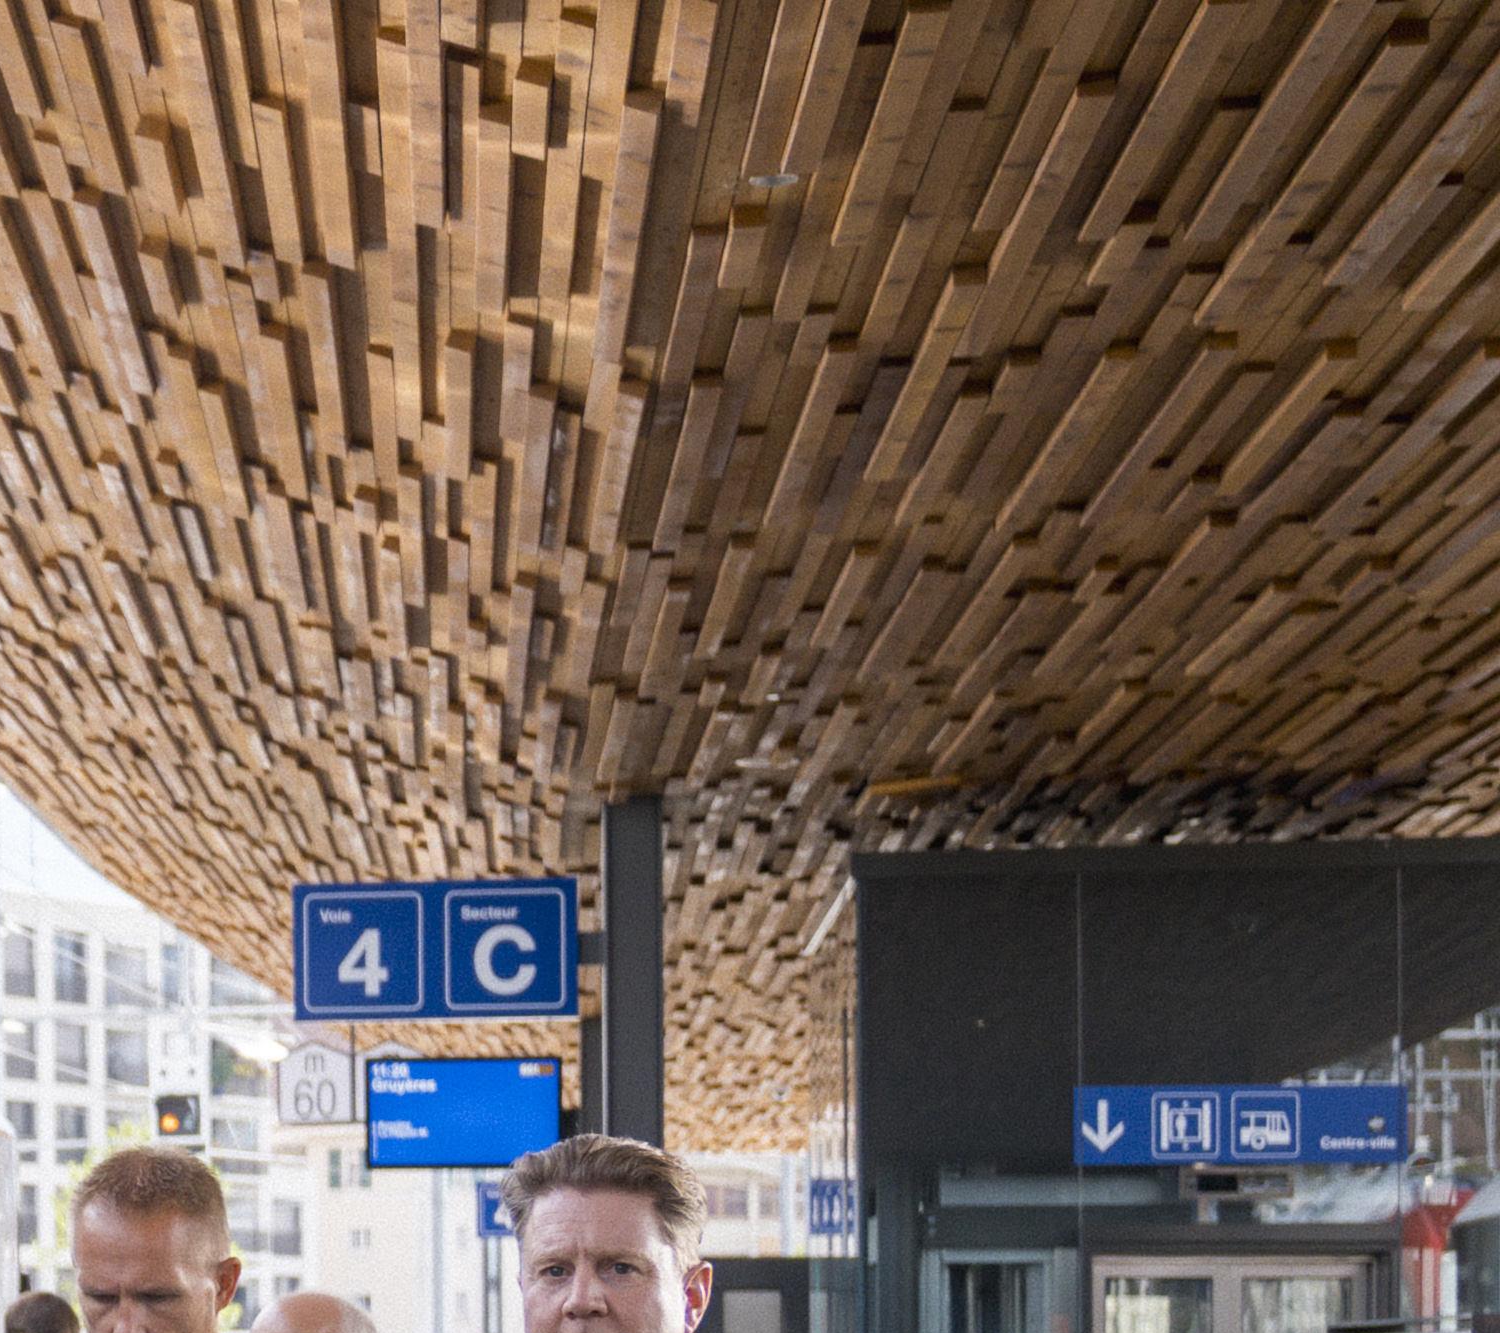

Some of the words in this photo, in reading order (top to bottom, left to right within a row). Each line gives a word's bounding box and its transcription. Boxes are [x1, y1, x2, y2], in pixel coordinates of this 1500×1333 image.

[320, 908, 351, 924] Voie
[461, 905, 518, 921] Secteur
[338, 928, 389, 997] 4
[474, 924, 537, 996] C
[304, 1053, 324, 1073] m
[294, 1079, 336, 1119] 60
[1320, 1135, 1397, 1151] Centre-ville
